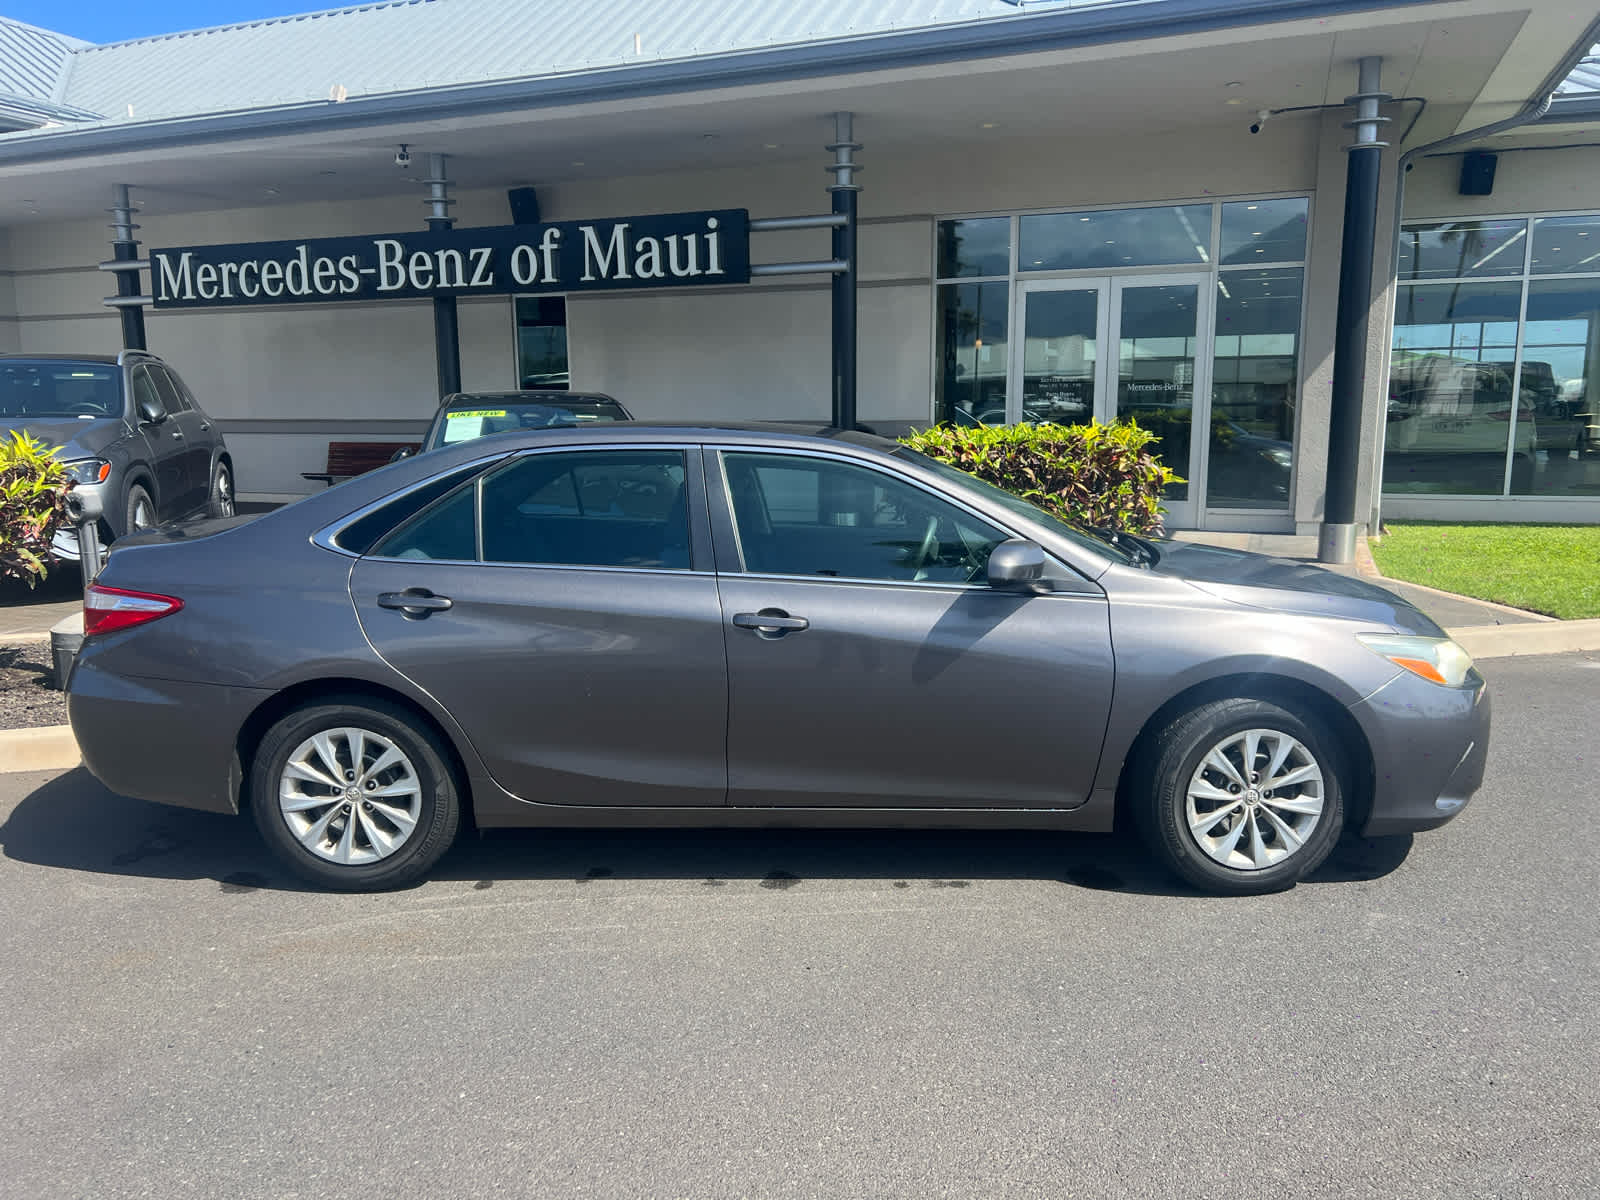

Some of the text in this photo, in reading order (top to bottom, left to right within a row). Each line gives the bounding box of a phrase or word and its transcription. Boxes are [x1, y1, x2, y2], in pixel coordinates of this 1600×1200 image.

[155, 216, 725, 301] Mercedes-Benz of Maui
[1127, 383, 1185, 392] Mercedes-Benz
